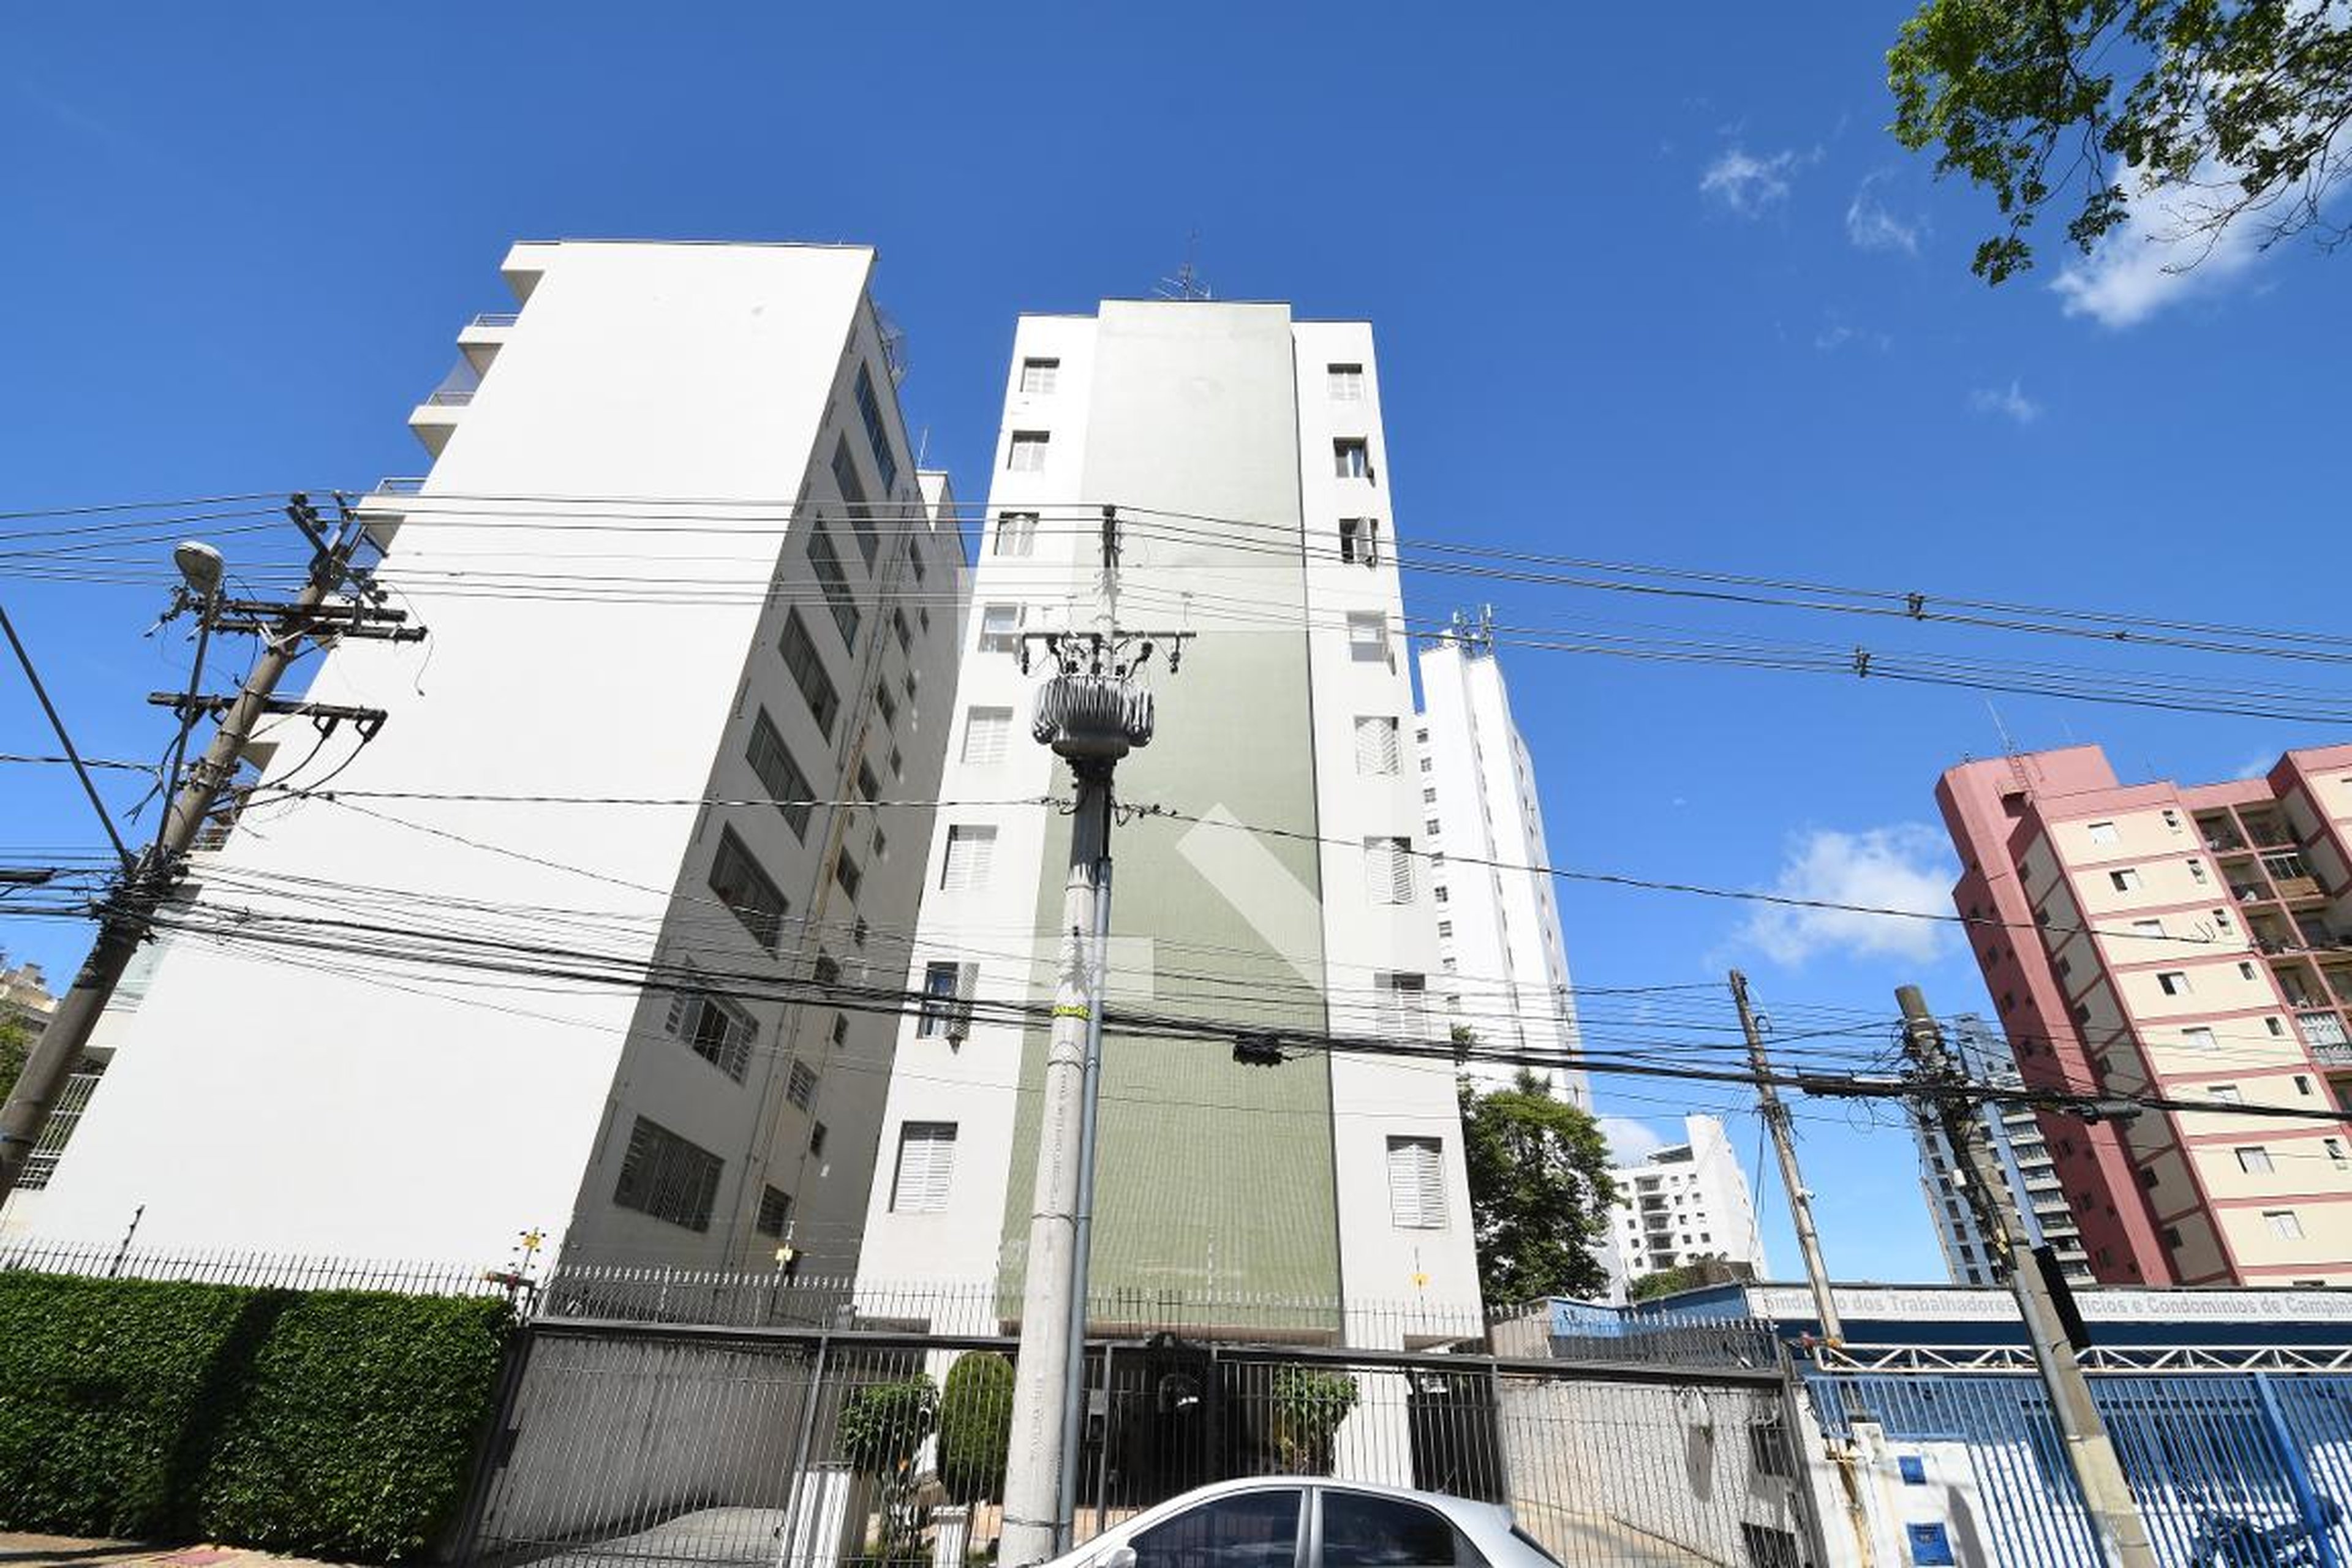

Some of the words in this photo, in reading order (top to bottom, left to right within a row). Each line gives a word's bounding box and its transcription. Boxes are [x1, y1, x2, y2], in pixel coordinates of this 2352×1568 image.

[1852, 1294, 1885, 1311] dos
[1888, 1294, 2016, 1312] Trabalhadores
[2133, 1299, 2144, 1313] e
[2261, 1295, 2282, 1313] de
